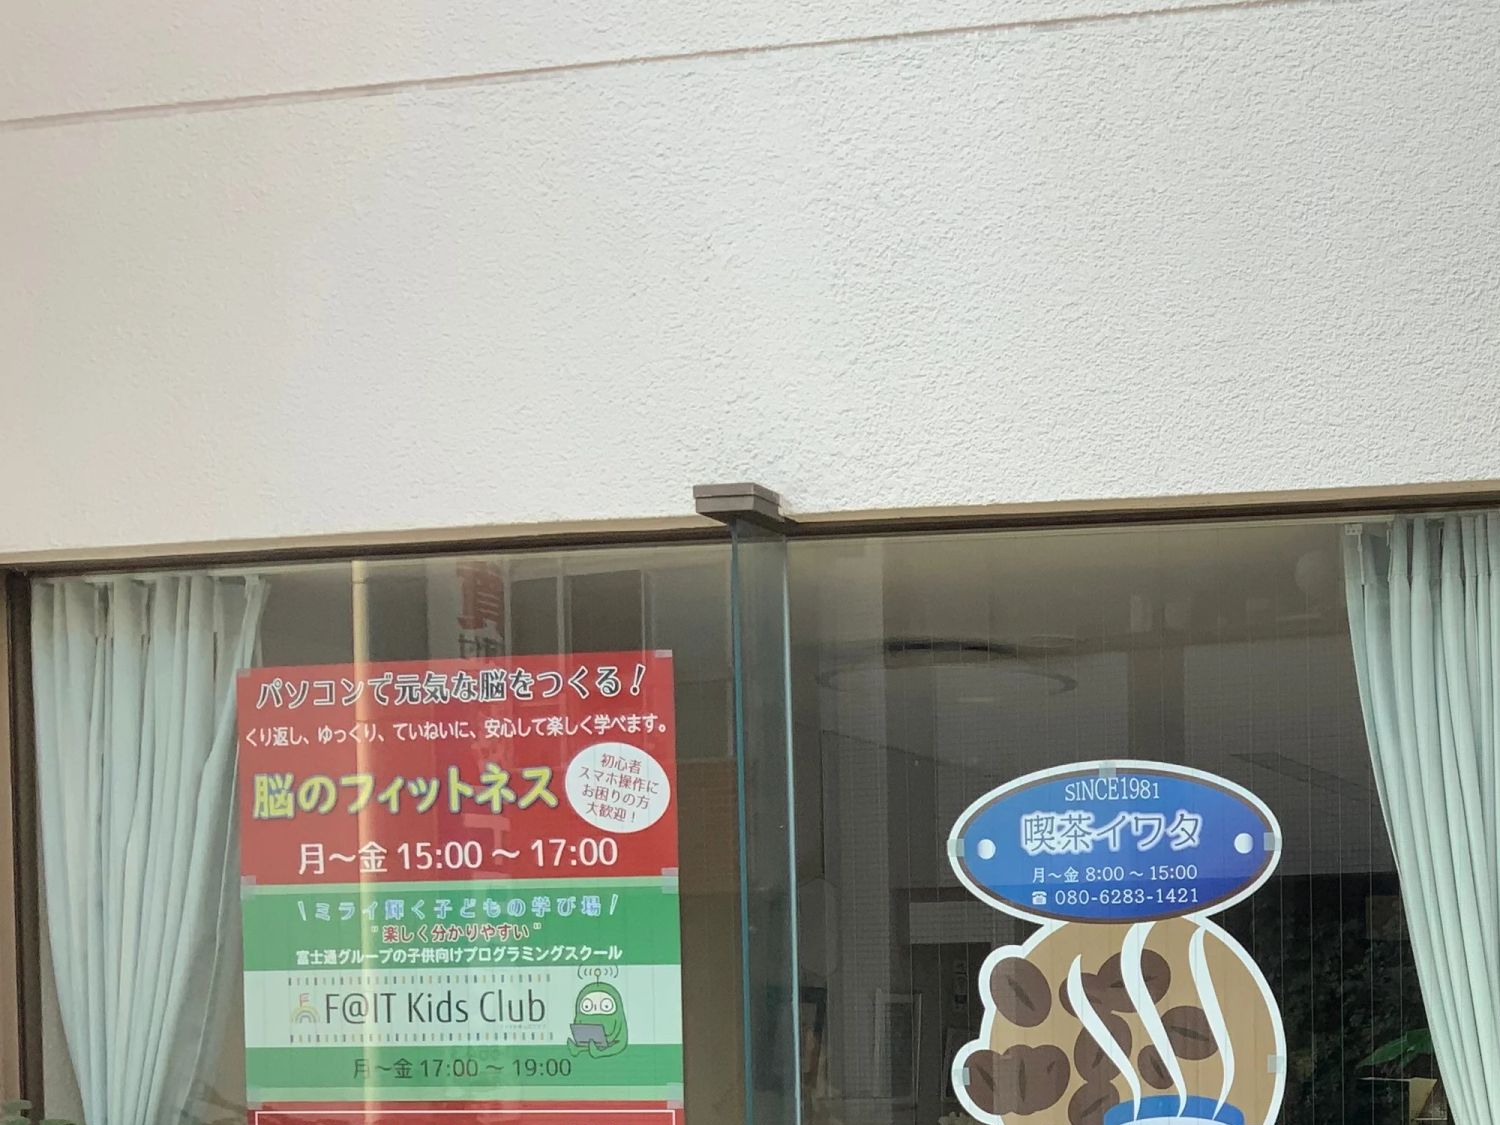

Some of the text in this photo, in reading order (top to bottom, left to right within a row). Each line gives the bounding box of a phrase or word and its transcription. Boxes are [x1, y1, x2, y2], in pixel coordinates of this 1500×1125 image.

[600, 753, 642, 775] 初心者
[253, 764, 559, 819] 脳のフィットネス
[579, 766, 660, 795] スマホ操作に
[1065, 777, 1160, 801] SINCE1981
[582, 784, 650, 810] お困りの方
[1022, 810, 1202, 854] 喫茶イワタ
[398, 840, 482, 870] 15:00
[531, 838, 618, 867] 17:00
[1085, 866, 1125, 881] 8:00
[1150, 864, 1198, 881] 15:00
[1055, 887, 1199, 905] 080-6283-1421
[296, 945, 623, 966] 富士通グループの子供向けプログラミングスクール
[325, 989, 546, 1024] F@IT Kids Club
[420, 1059, 478, 1078] 17:00
[513, 1058, 572, 1078] 19:00
